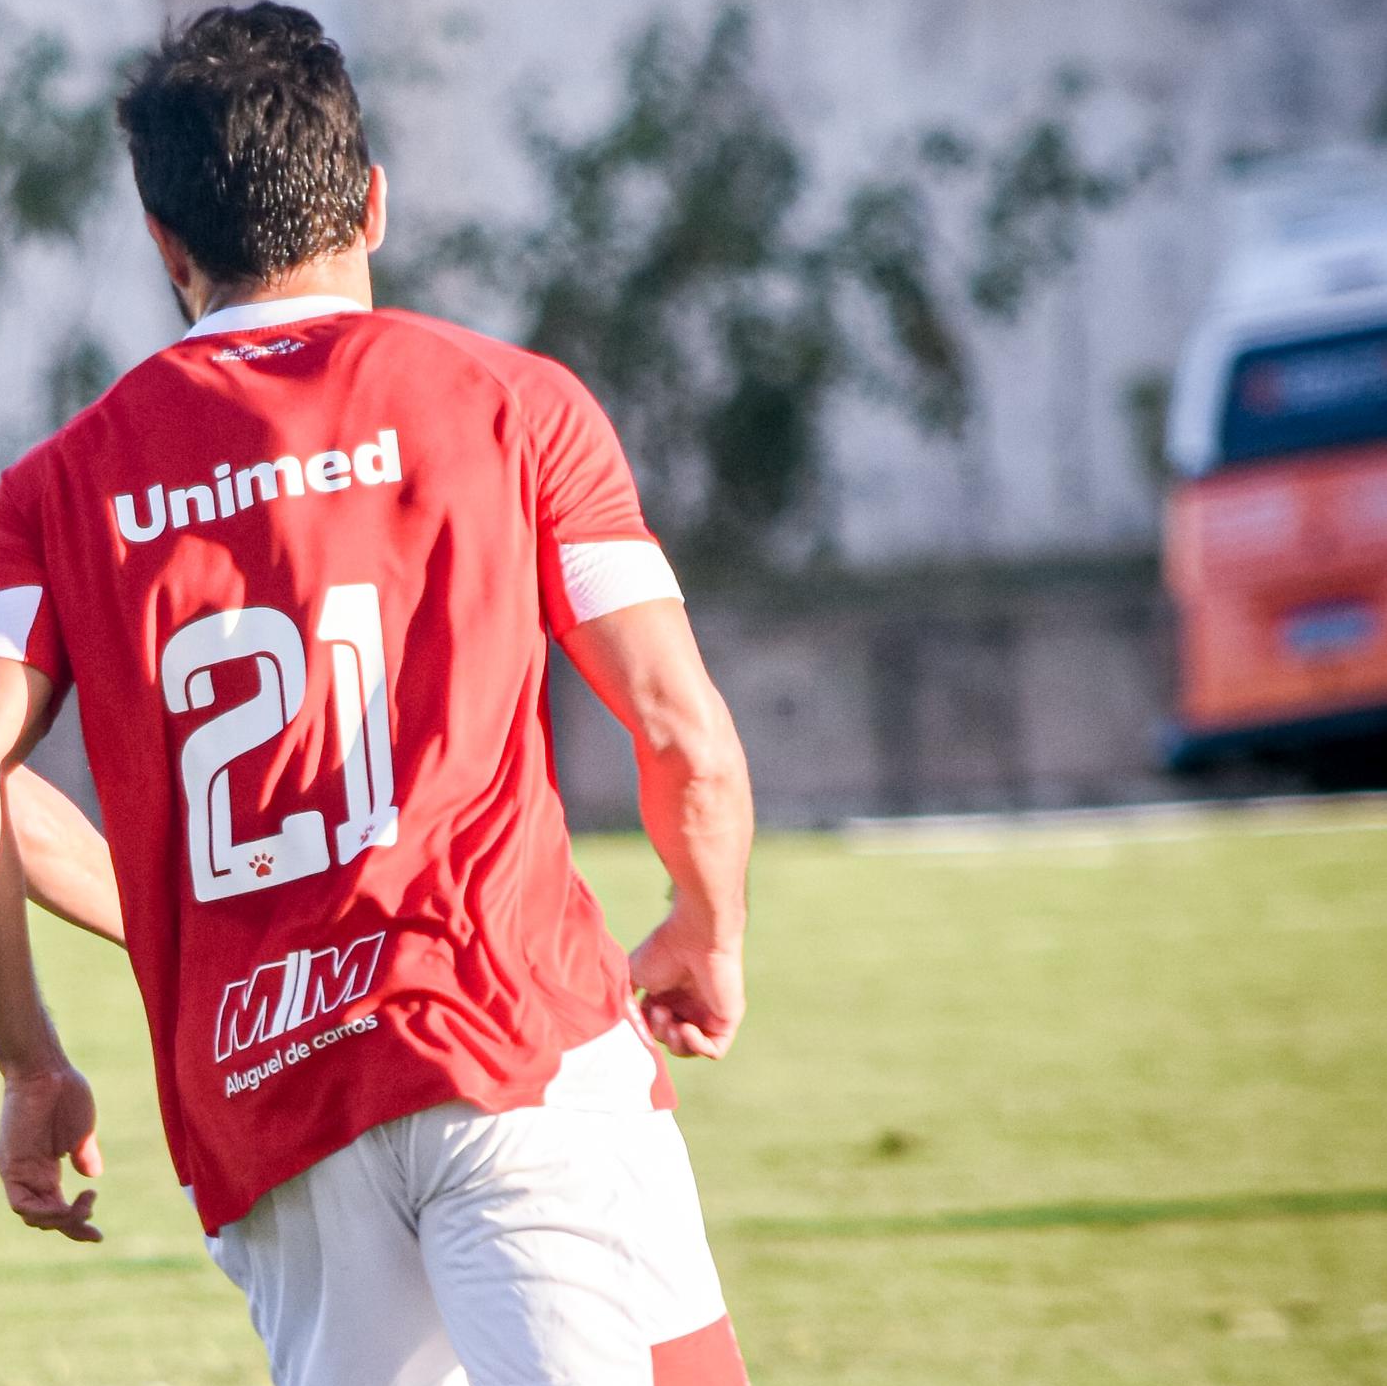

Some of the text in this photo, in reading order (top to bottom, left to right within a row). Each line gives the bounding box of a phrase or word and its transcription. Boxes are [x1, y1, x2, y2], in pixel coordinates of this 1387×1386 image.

[115, 429, 402, 543] Unimed
[161, 583, 399, 903] 21
[225, 1014, 378, 1098] Aluguel de carros
